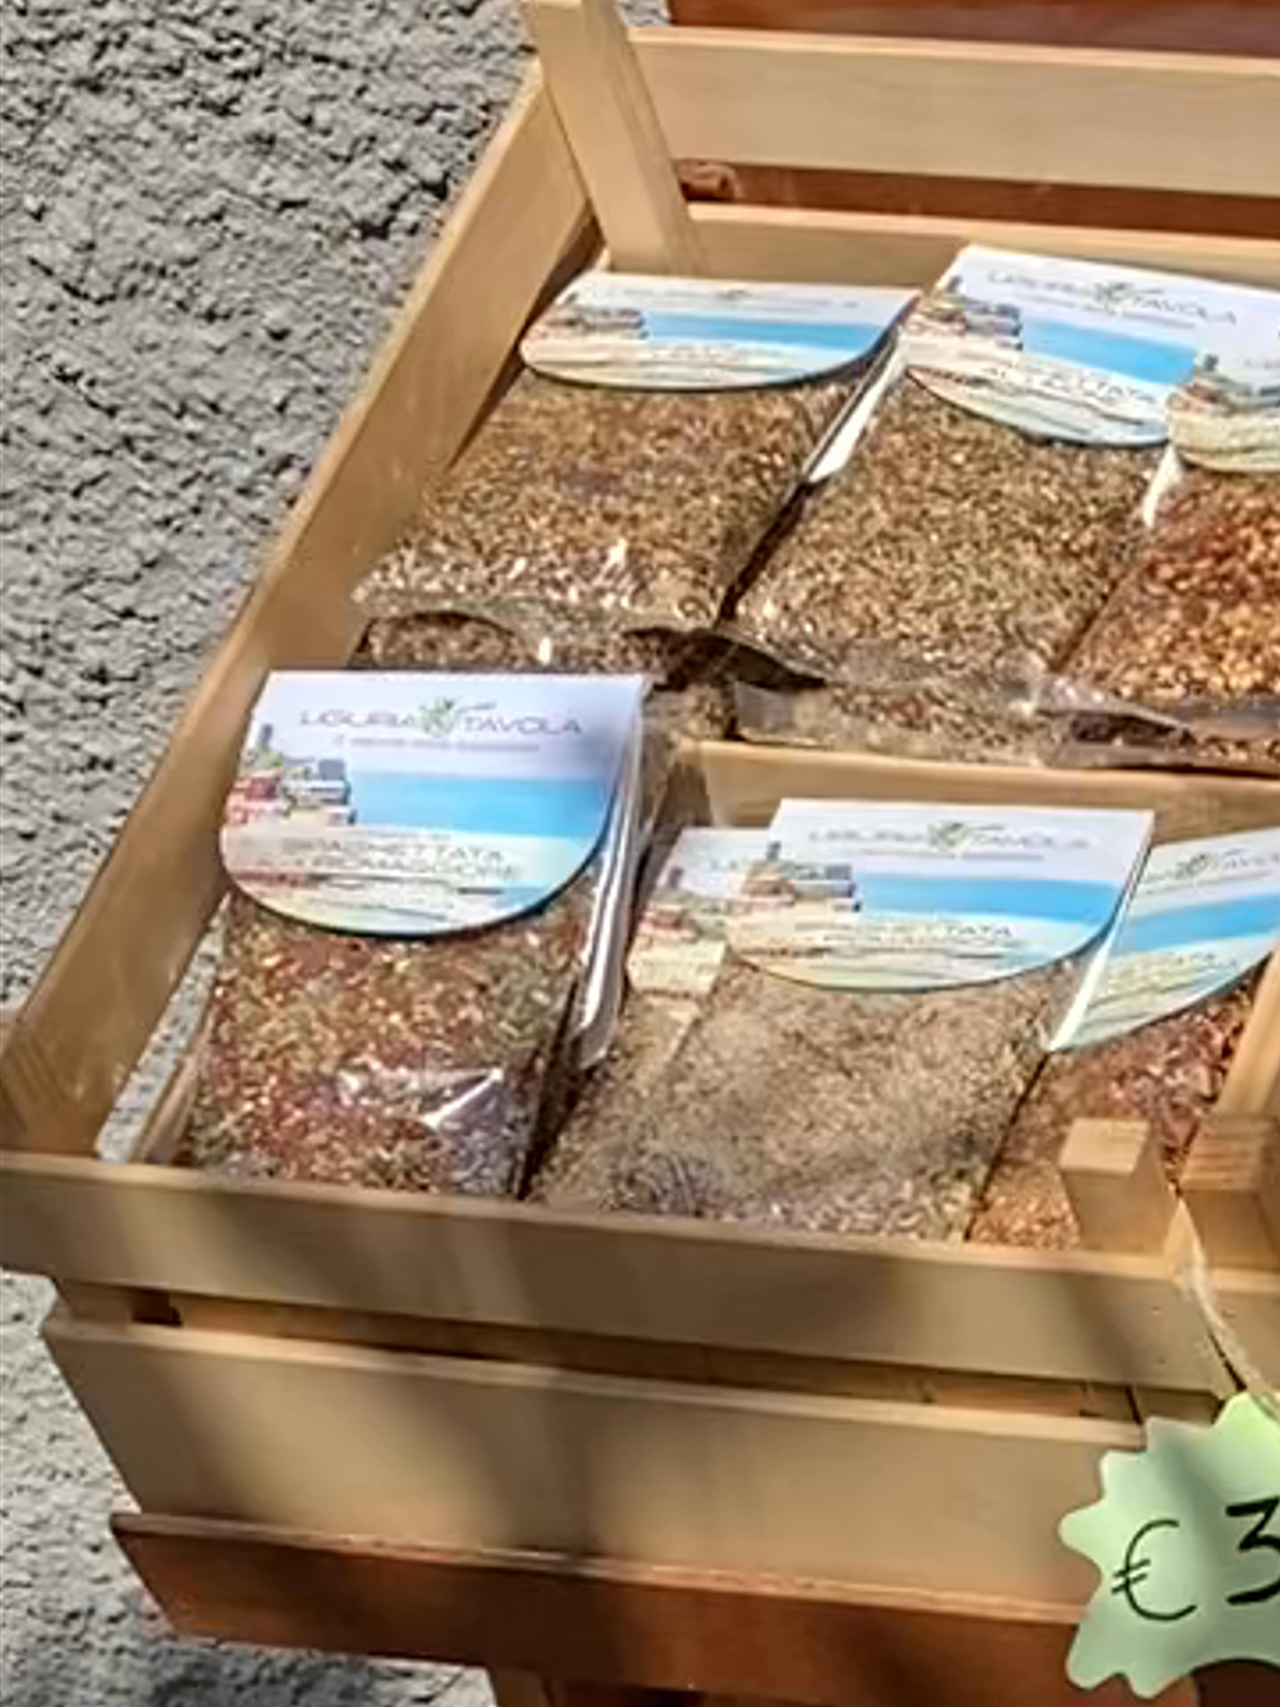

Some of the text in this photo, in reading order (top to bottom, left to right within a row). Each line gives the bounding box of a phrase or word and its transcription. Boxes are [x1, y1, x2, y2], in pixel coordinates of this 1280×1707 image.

[300, 708, 583, 736] LIGURIA TAVOLA
[1110, 1518, 1198, 1622] €
